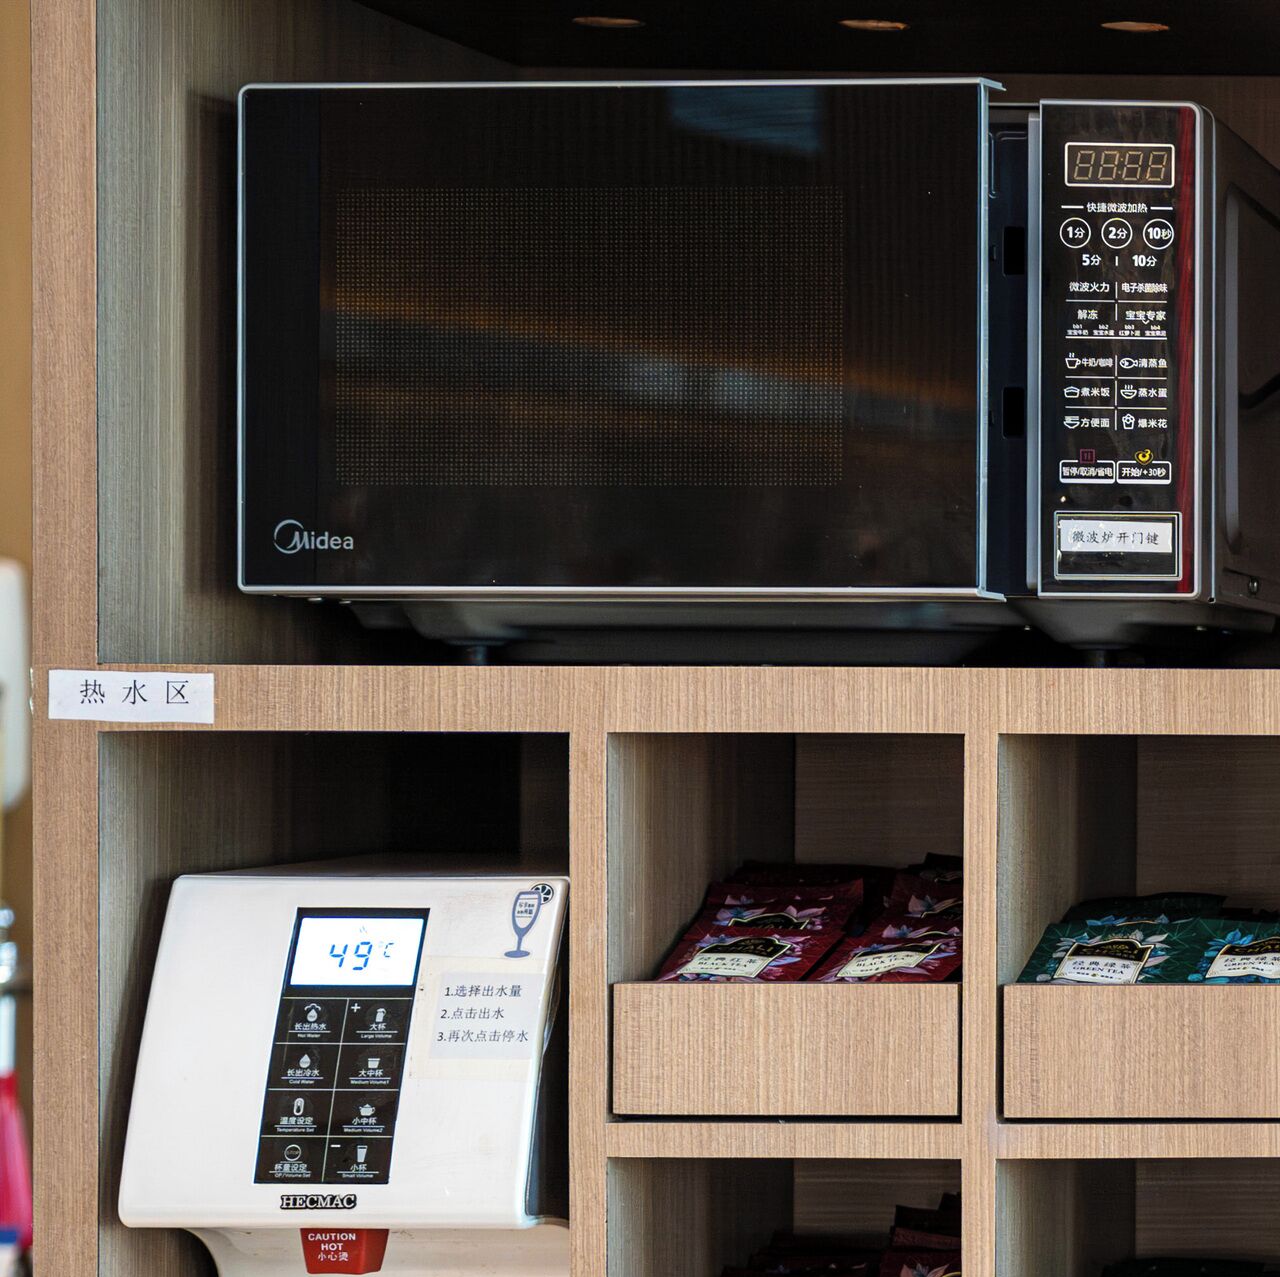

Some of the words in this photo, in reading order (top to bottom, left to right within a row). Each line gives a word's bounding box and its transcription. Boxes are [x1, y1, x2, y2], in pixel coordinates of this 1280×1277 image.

[1087, 202, 1148, 213] 快捷微波加热
[1067, 227, 1085, 238] 1分
[1108, 227, 1127, 239] 2分
[1148, 227, 1172, 240] 10秒
[1082, 254, 1101, 266] 5分
[1133, 255, 1157, 267] 10分
[1069, 282, 1110, 292] 微波火力
[1077, 310, 1099, 320] 解冻
[1125, 311, 1166, 320] 宝宝专家
[1138, 358, 1167, 369] 清蒸鱼
[1081, 387, 1110, 396] 煮米饭
[1138, 388, 1167, 398] 蒸水蛋
[1081, 418, 1110, 428] 方便面
[1138, 418, 1167, 428] 爆米花
[272, 518, 354, 556] Midea
[1072, 530, 1159, 545] 微波炉开门键
[79, 679, 190, 706] 热水区
[444, 985, 522, 997] 1.选择出水量
[440, 1007, 504, 1020] 2.点击出水
[437, 1030, 529, 1042] 3.再次点击停水
[287, 1069, 320, 1077] 长出冷水
[358, 1069, 384, 1077] 大中杯
[280, 1117, 313, 1125] 温度设定
[352, 1117, 376, 1125] 小中杯
[350, 1164, 367, 1172] 小杯
[281, 1195, 357, 1209] HECMAC
[318, 1252, 348, 1261] 小心烫
